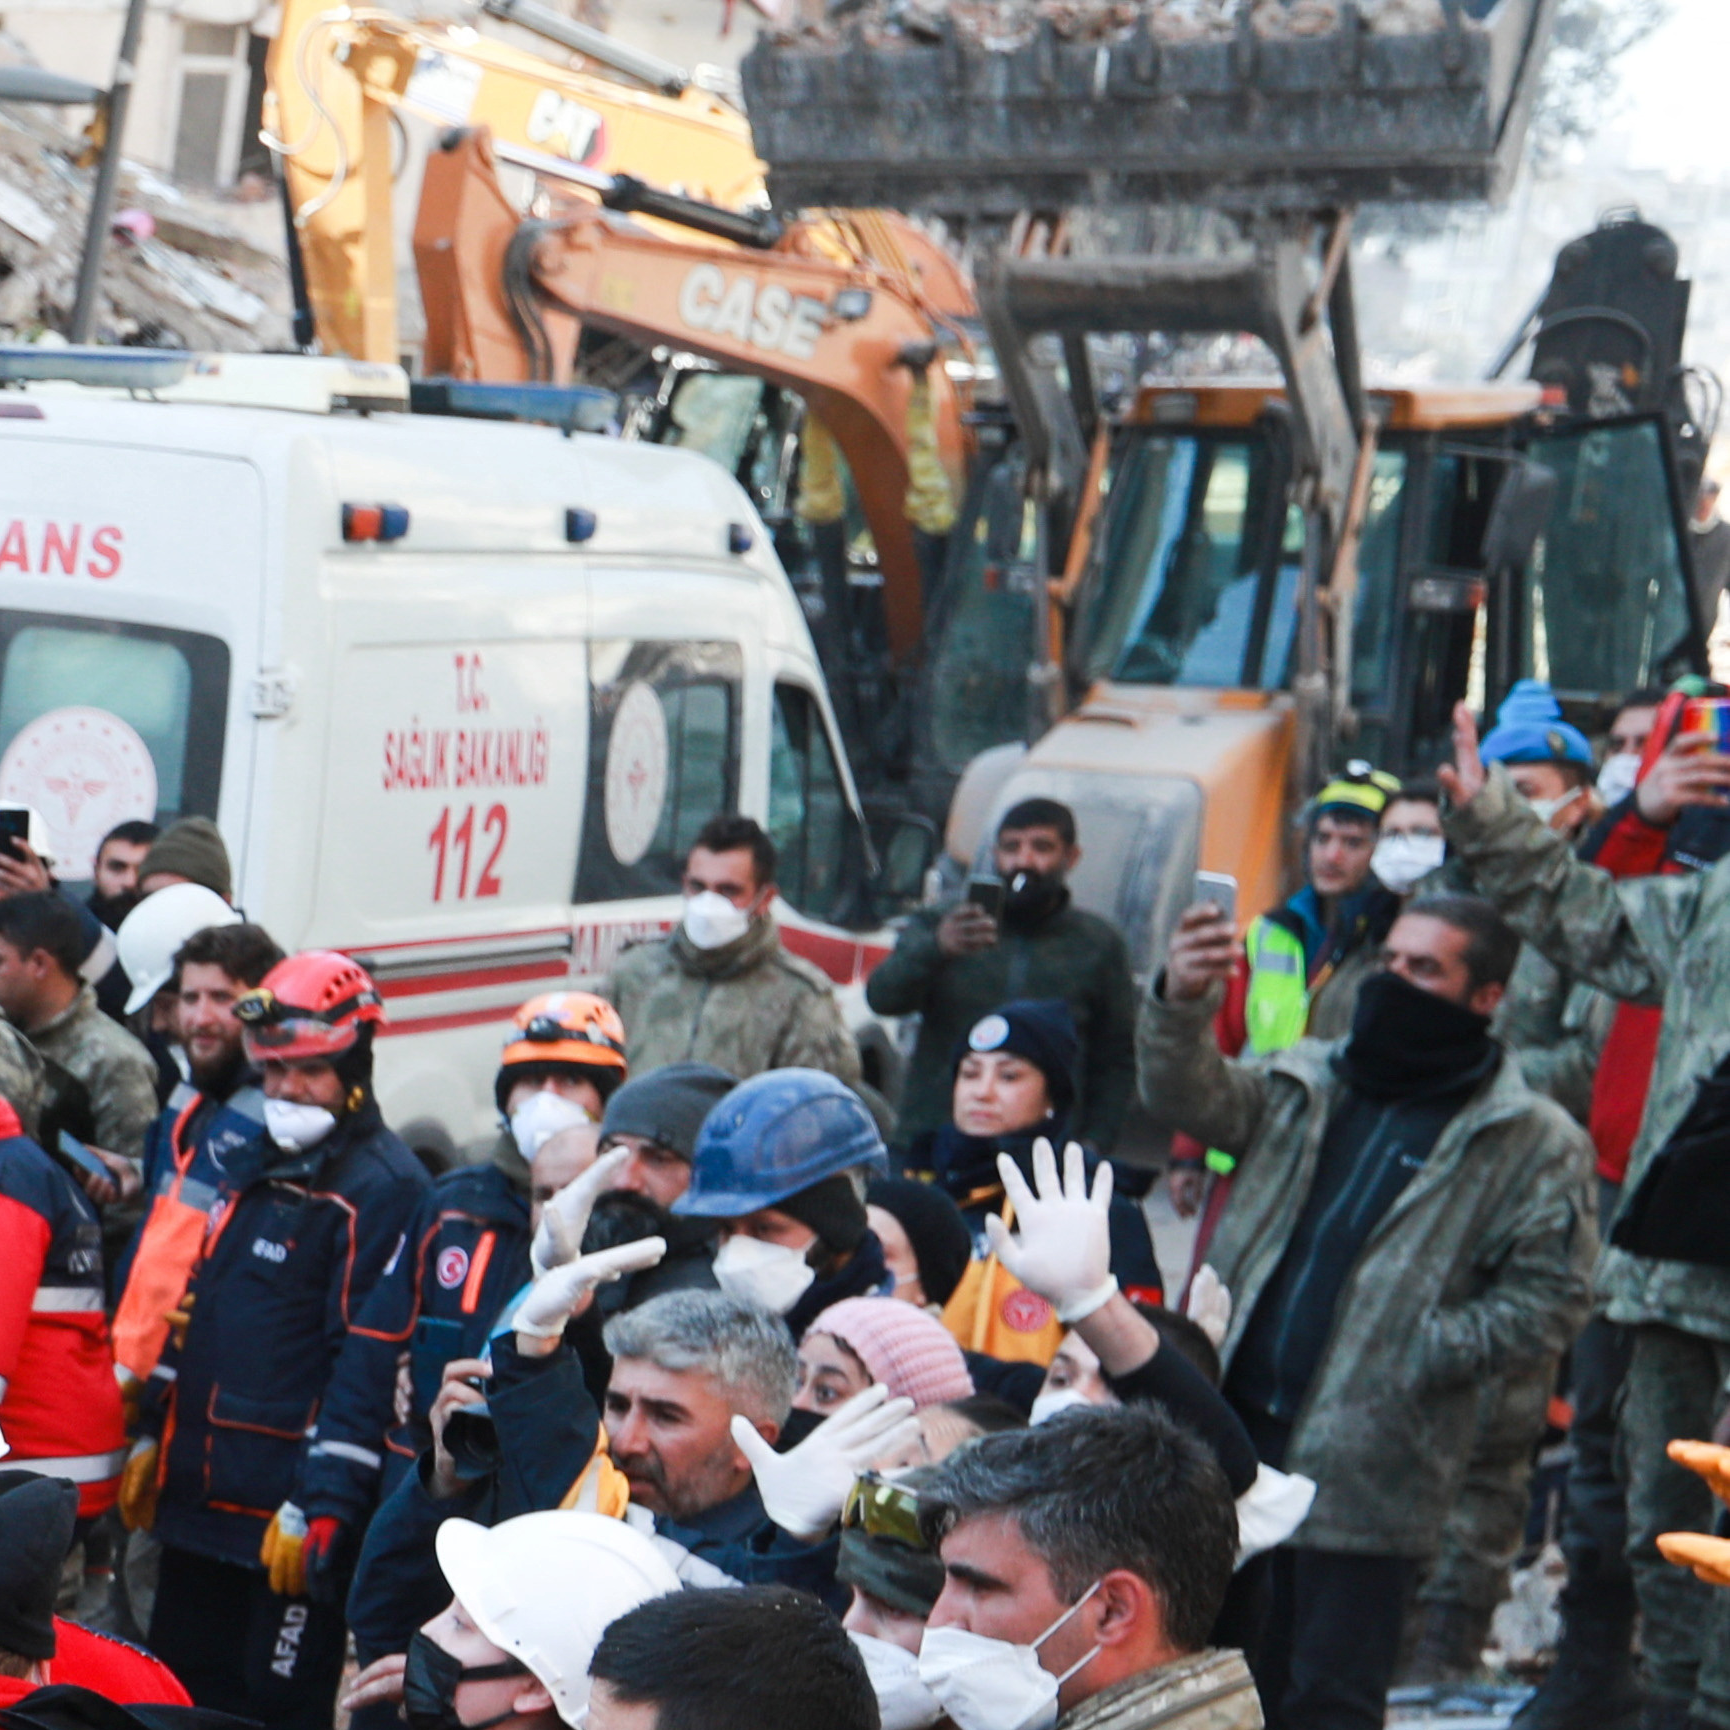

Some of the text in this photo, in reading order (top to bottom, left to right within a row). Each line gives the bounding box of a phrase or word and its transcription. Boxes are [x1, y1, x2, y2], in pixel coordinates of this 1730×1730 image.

[679, 262, 830, 360] CASE
[382, 714, 450, 790] SAĞLIK
[428, 803, 509, 903] 112
[271, 1604, 309, 1678] AFAD
